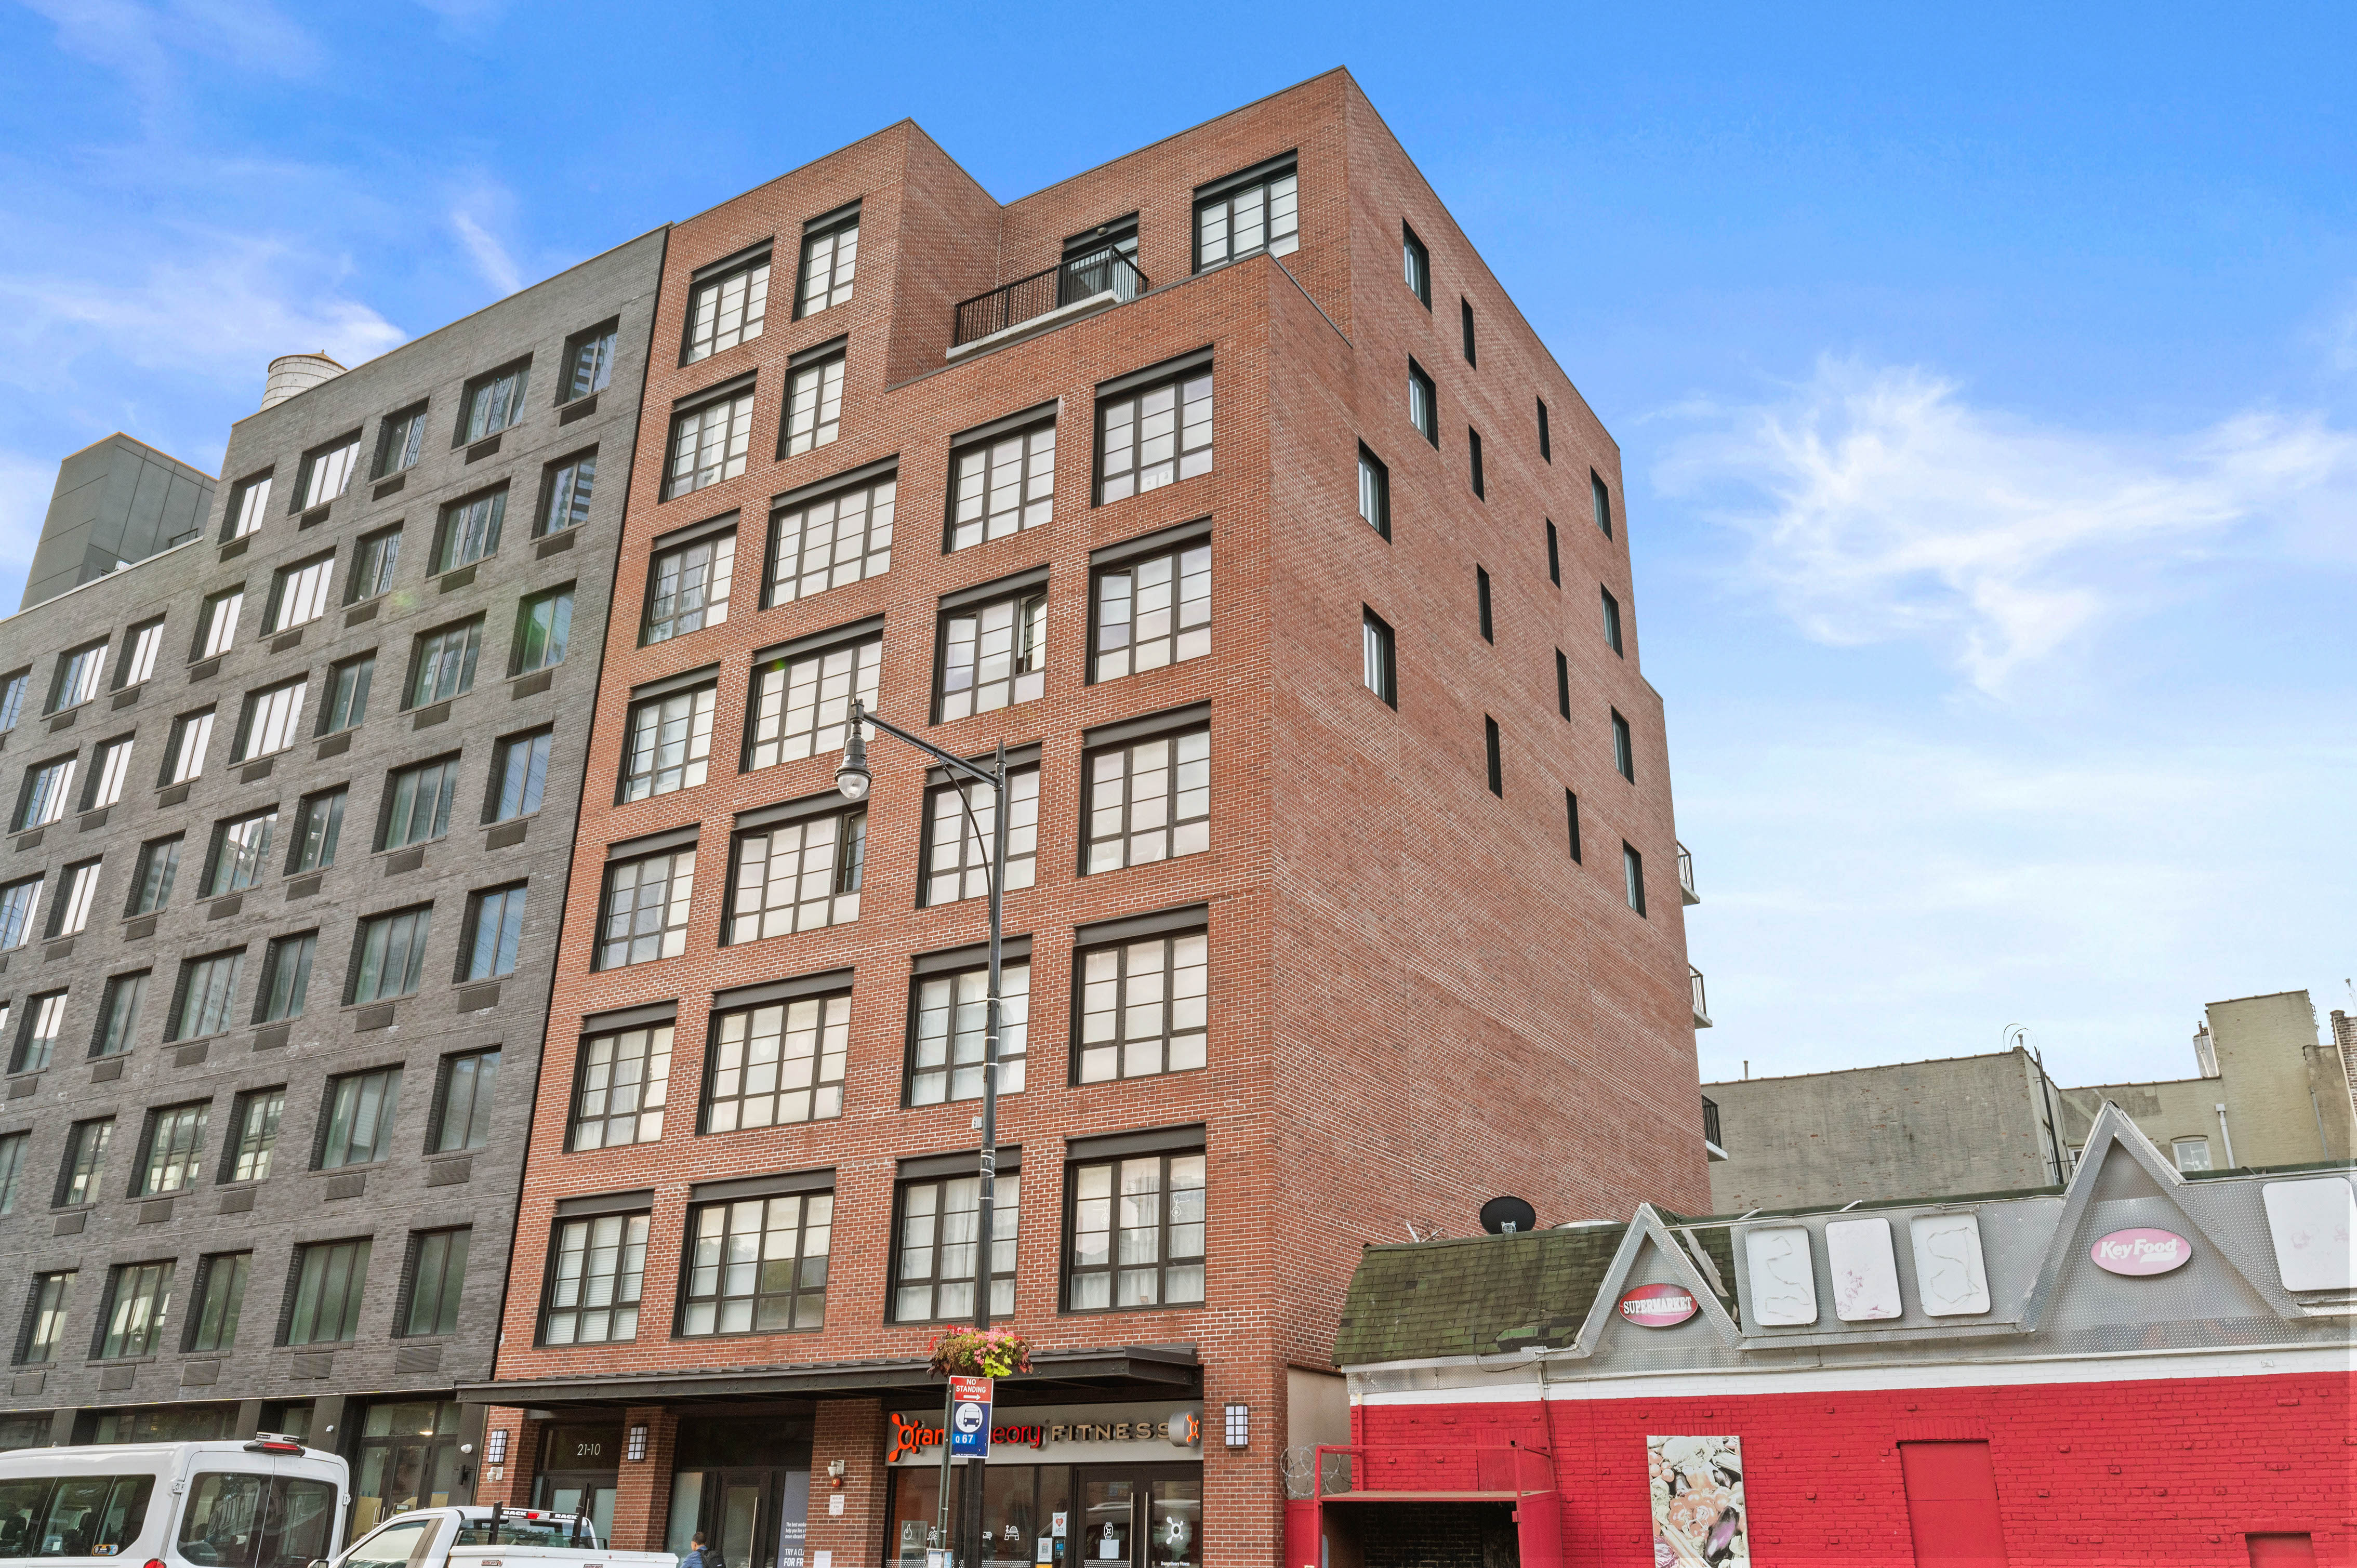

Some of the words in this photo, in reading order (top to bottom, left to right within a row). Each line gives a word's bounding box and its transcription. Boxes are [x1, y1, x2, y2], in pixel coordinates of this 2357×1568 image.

[2100, 1241, 2133, 1260] Key
[2133, 1238, 2177, 1256] Food
[1623, 1296, 1693, 1315] SUPERMARKET
[956, 1385, 986, 1393] STANDING
[889, 1414, 1040, 1461] Oraneory
[1051, 1422, 1169, 1442] FITNESS
[577, 1443, 601, 1455] 21-10
[784, 1558, 795, 1567] FOR
